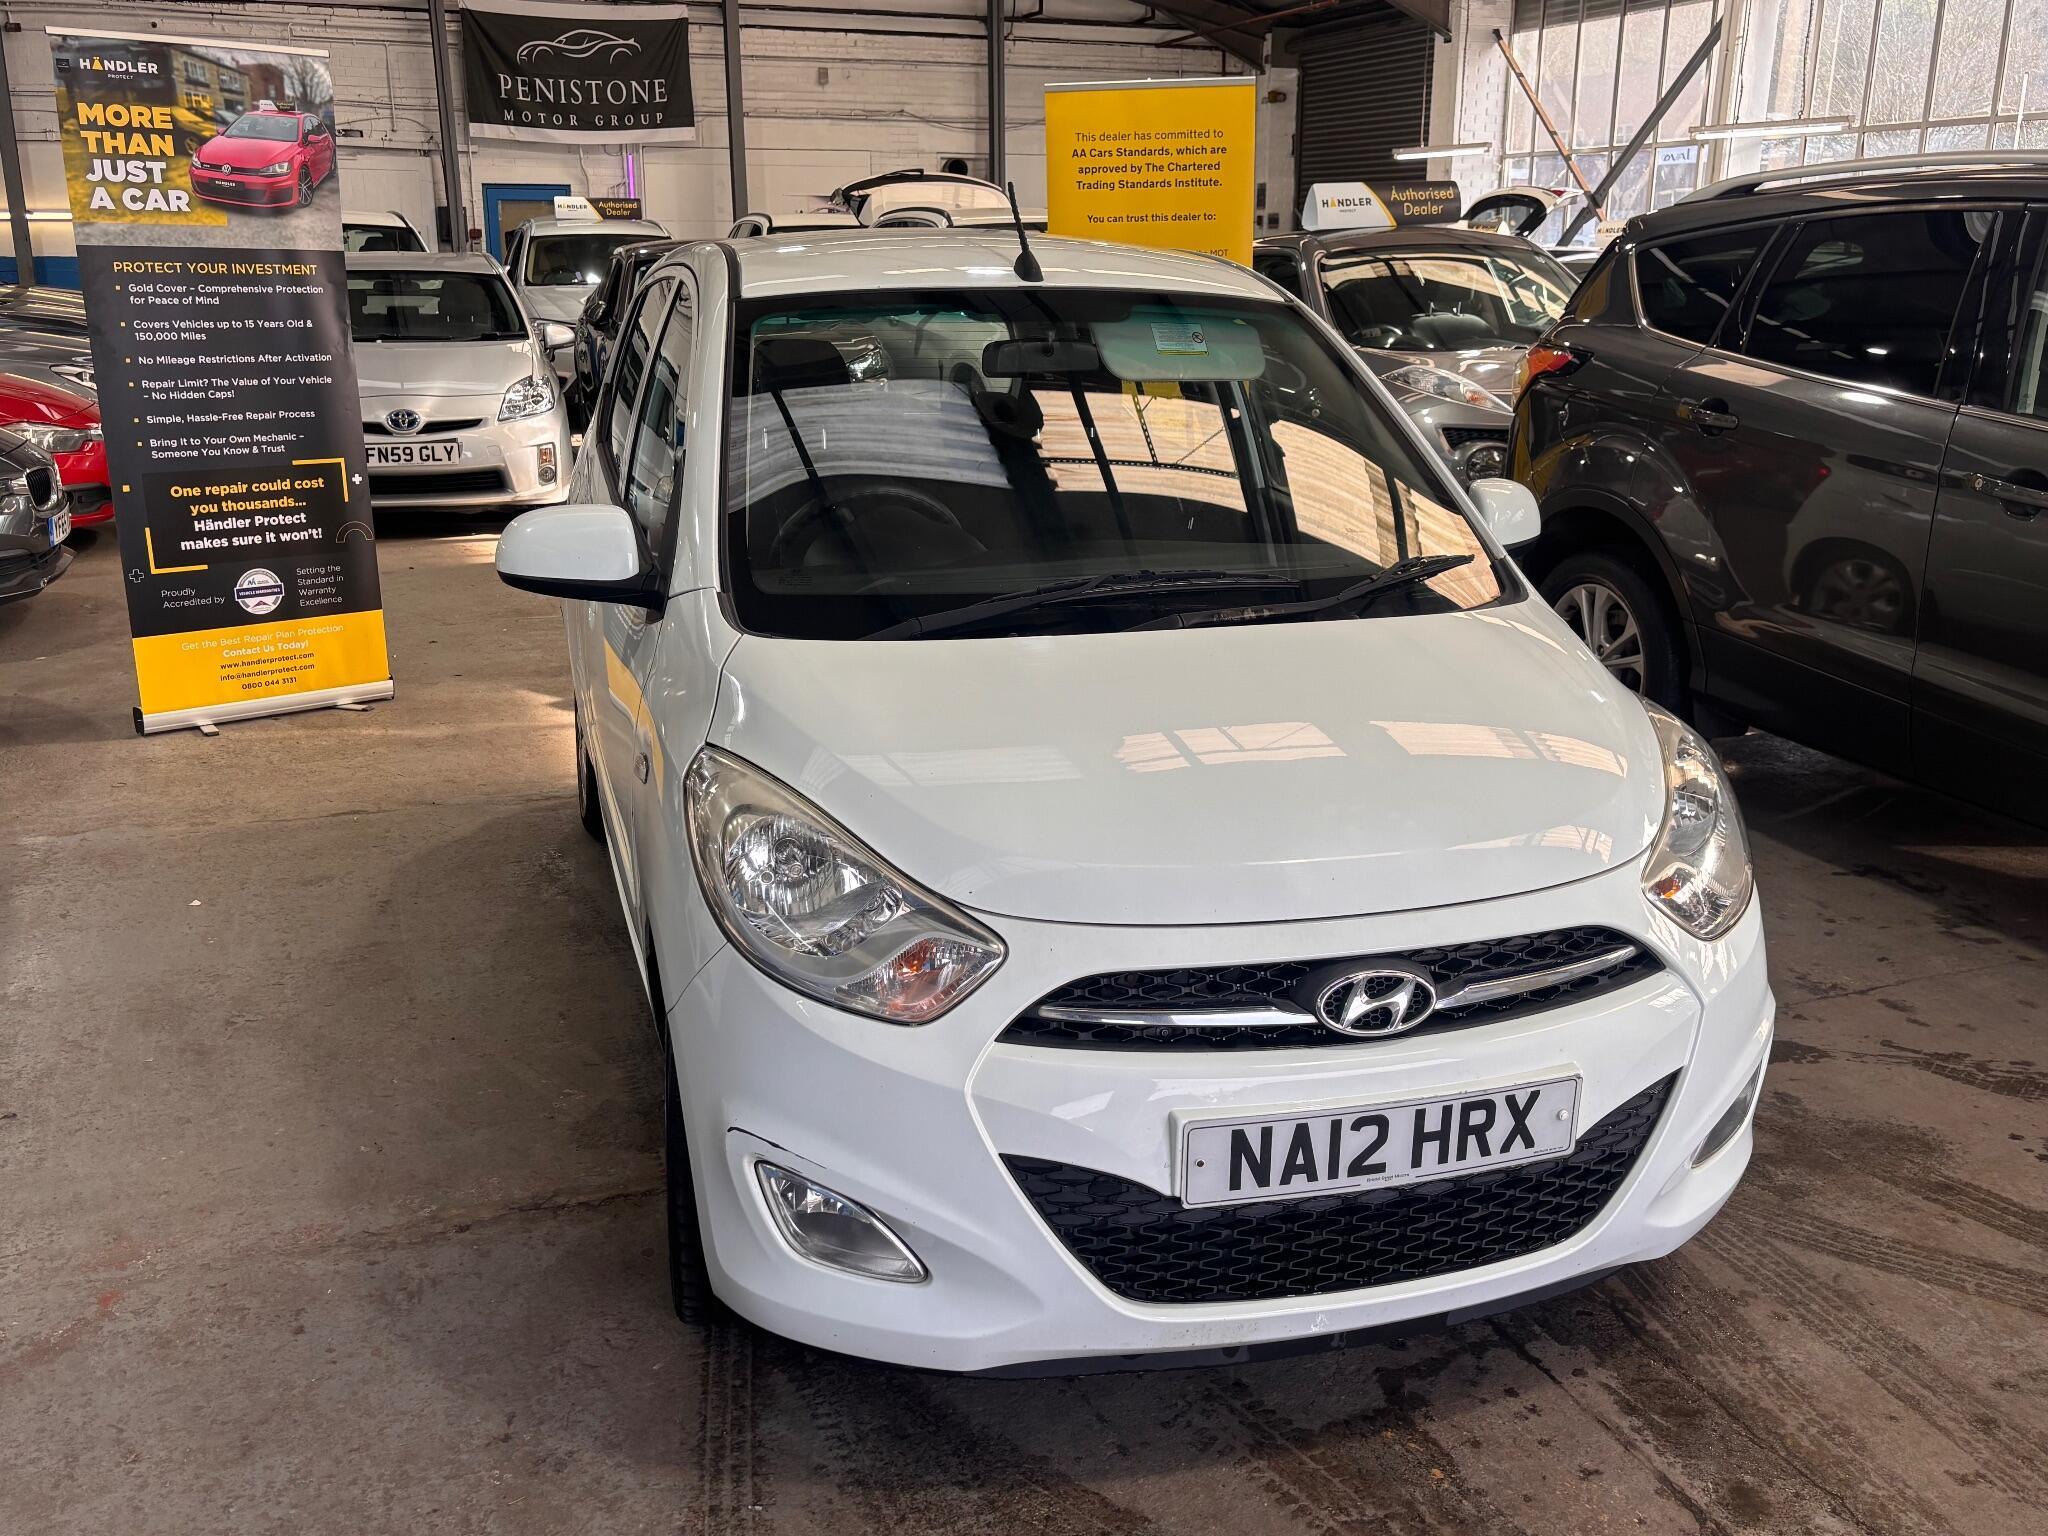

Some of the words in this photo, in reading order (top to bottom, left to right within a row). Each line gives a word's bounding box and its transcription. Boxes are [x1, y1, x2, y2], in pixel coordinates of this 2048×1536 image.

[80, 56, 158, 74] HÄNDLER
[498, 74, 668, 105] PENISTONE
[77, 102, 173, 129] MORE
[504, 110, 578, 126] MOTOR
[595, 112, 664, 126] GROUP
[1075, 132, 1096, 142] This
[1100, 131, 1131, 141] dealer
[1134, 131, 1152, 140] has
[1154, 129, 1210, 140] committed
[1213, 130, 1224, 138] to
[80, 131, 175, 156] THAN
[1072, 149, 1087, 158] AA
[1089, 148, 1113, 158] Cars
[1116, 146, 1173, 157] Standards,
[1176, 146, 1207, 155] which
[1210, 146, 1227, 154] are
[86, 159, 166, 183] JUST
[1078, 163, 1127, 175] approved
[1130, 164, 1142, 174] by
[1145, 163, 1164, 172] The
[1167, 161, 1220, 171] Chartered
[1076, 180, 1115, 191] Trading
[1118, 179, 1172, 189] Standards
[1175, 177, 1222, 188] Institute.
[90, 187, 116, 209] A
[122, 188, 191, 212] CAR
[1391, 186, 1454, 201] Authorised
[599, 201, 637, 209] Authorised
[1404, 202, 1443, 216] Dealer
[1087, 215, 1104, 223] You
[1107, 215, 1124, 223] can
[1126, 214, 1148, 222] trust
[1151, 213, 1168, 222] this
[1171, 212, 1201, 221] dealer
[1203, 212, 1216, 221] to:
[113, 262, 182, 273] PROTECT
[186, 262, 228, 274] YOUR
[232, 264, 317, 275] INVESTMENT
[129, 284, 153, 293] Gold
[156, 284, 187, 293] Cover
[198, 285, 273, 295] Comprehensive
[276, 285, 323, 294] Protection
[130, 296, 145, 305] for
[148, 296, 179, 305] Peace
[182, 296, 193, 305] of
[196, 296, 220, 305] Mind
[134, 320, 169, 329] Covers
[172, 320, 214, 329] Vehicles
[217, 321, 230, 330] up
[232, 320, 242, 329] to
[245, 320, 254, 328] 15
[257, 320, 284, 328] Years
[287, 319, 304, 328] Old
[306, 320, 313, 328] &
[135, 332, 178, 342] 150,000
[181, 331, 206, 340] Miles
[138, 356, 153, 365] No
[156, 356, 195, 366] Mileage
[199, 354, 255, 364] Restrictions
[258, 354, 282, 363] After
[285, 353, 332, 362] Activation
[142, 379, 175, 390] Repair
[178, 378, 208, 388] Limit?
[211, 378, 229, 386] The
[232, 377, 259, 386] Value
[261, 377, 271, 385] of
[273, 377, 296, 385] Your
[298, 376, 332, 384] Vehicle
[152, 392, 166, 400] No
[169, 391, 206, 400] Hidden
[208, 390, 235, 400] Caps!
[146, 414, 184, 425] Simple,
[187, 412, 244, 422] Hassle-Free
[246, 411, 276, 421] Repair
[279, 410, 315, 418] Process
[150, 438, 178, 448] Bring
[190, 437, 200, 445] to
[203, 436, 226, 445] Your
[229, 435, 251, 444] Own
[253, 433, 297, 442] Mechanic
[152, 449, 198, 459] Someone
[201, 448, 220, 456] You
[223, 446, 250, 455] Know
[252, 446, 259, 454] &
[261, 444, 285, 453] Trust
[366, 446, 413, 463] FN59
[419, 446, 455, 462] GLY
[170, 486, 202, 497] One
[205, 482, 249, 495] repair
[252, 479, 291, 492] could
[295, 477, 324, 489] cost
[190, 503, 218, 517] you
[222, 496, 306, 512] thousands...
[194, 516, 250, 532] Händler
[255, 512, 306, 527] Protect
[181, 536, 229, 550] makes
[232, 534, 262, 546] sure
[266, 532, 277, 543] it
[297, 567, 326, 578] Setting
[328, 565, 341, 573] the
[298, 576, 334, 586] Standard
[336, 575, 344, 583] in
[161, 588, 196, 599] Proudly
[299, 586, 337, 597] Warranty
[163, 597, 212, 609] Accredited
[215, 596, 225, 605] by
[300, 596, 343, 607] Excellence
[181, 642, 199, 651] Get
[201, 640, 217, 648] the
[220, 637, 242, 647] Best
[244, 634, 273, 645] Repair
[276, 631, 296, 640] Plan
[298, 625, 344, 637] Protection
[223, 647, 261, 658] Contact
[264, 644, 275, 653] Us
[278, 640, 309, 652] Today!
[220, 651, 314, 670] www.handlerprotect.com
[220, 663, 315, 682] info@handlerprotect.com
[242, 681, 263, 690] 0800
[264, 679, 280, 688] 044
[282, 677, 297, 686] 3131
[1229, 1114, 1390, 1191] NA12
[1411, 1089, 1541, 1169] HRX
